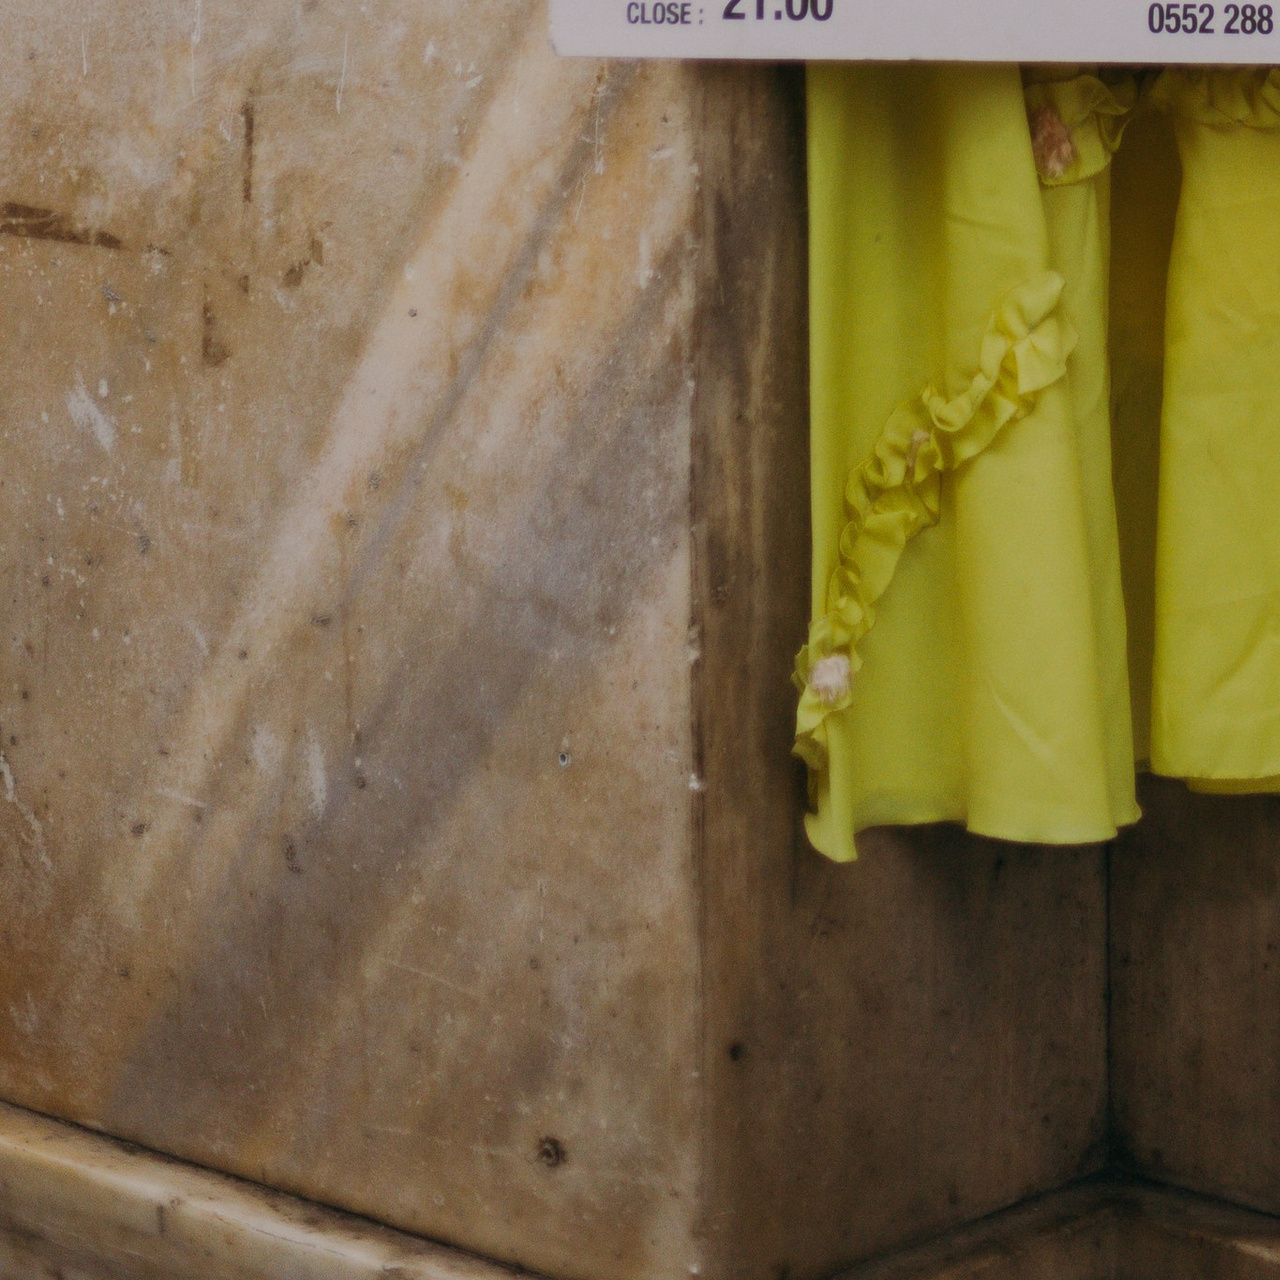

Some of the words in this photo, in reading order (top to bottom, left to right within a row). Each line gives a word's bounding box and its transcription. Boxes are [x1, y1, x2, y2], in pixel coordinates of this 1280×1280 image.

[626, 1, 692, 26] CLOSE
[1148, 2, 1215, 35] 0552
[1223, 4, 1274, 35] 288
